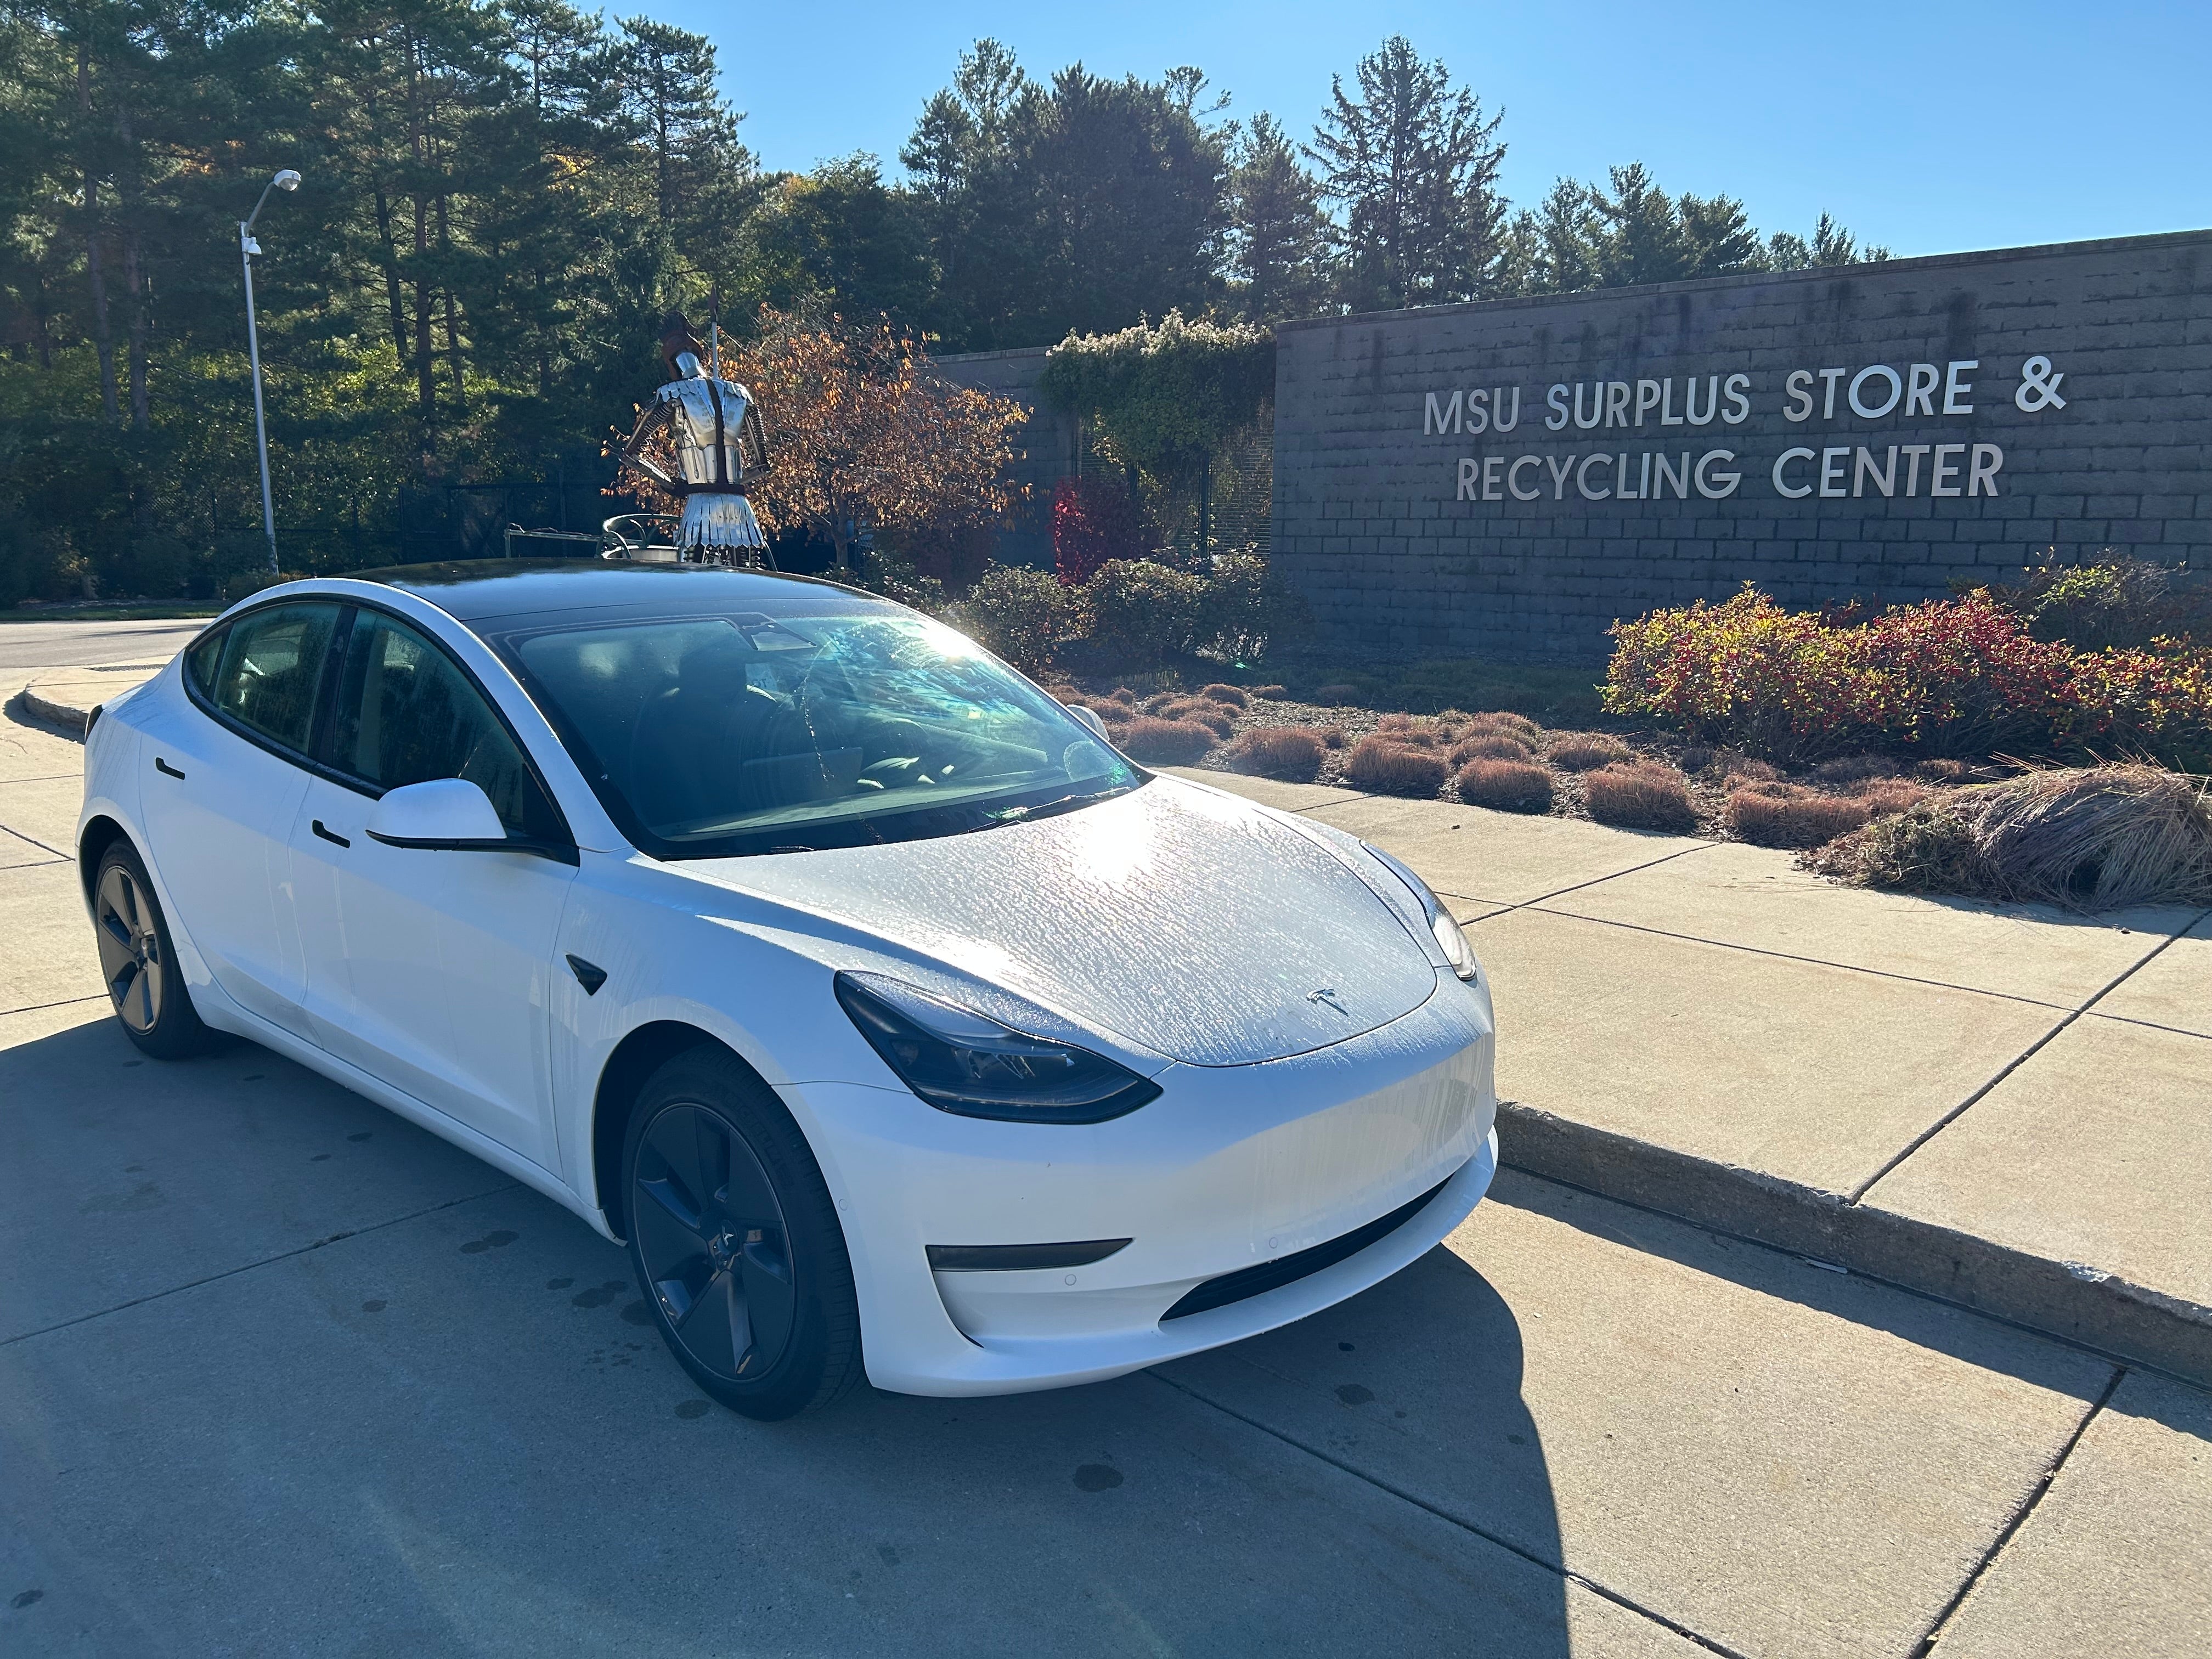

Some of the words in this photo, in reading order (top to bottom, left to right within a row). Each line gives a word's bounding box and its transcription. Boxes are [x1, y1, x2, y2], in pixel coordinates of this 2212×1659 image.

[1424, 387, 1520, 436] MSU
[1545, 374, 1750, 430] SURPLUS
[1783, 360, 1979, 422] STORE
[2015, 356, 2067, 412] &
[1457, 449, 1741, 500] RECYCLING
[1772, 443, 2004, 498] CENTER
